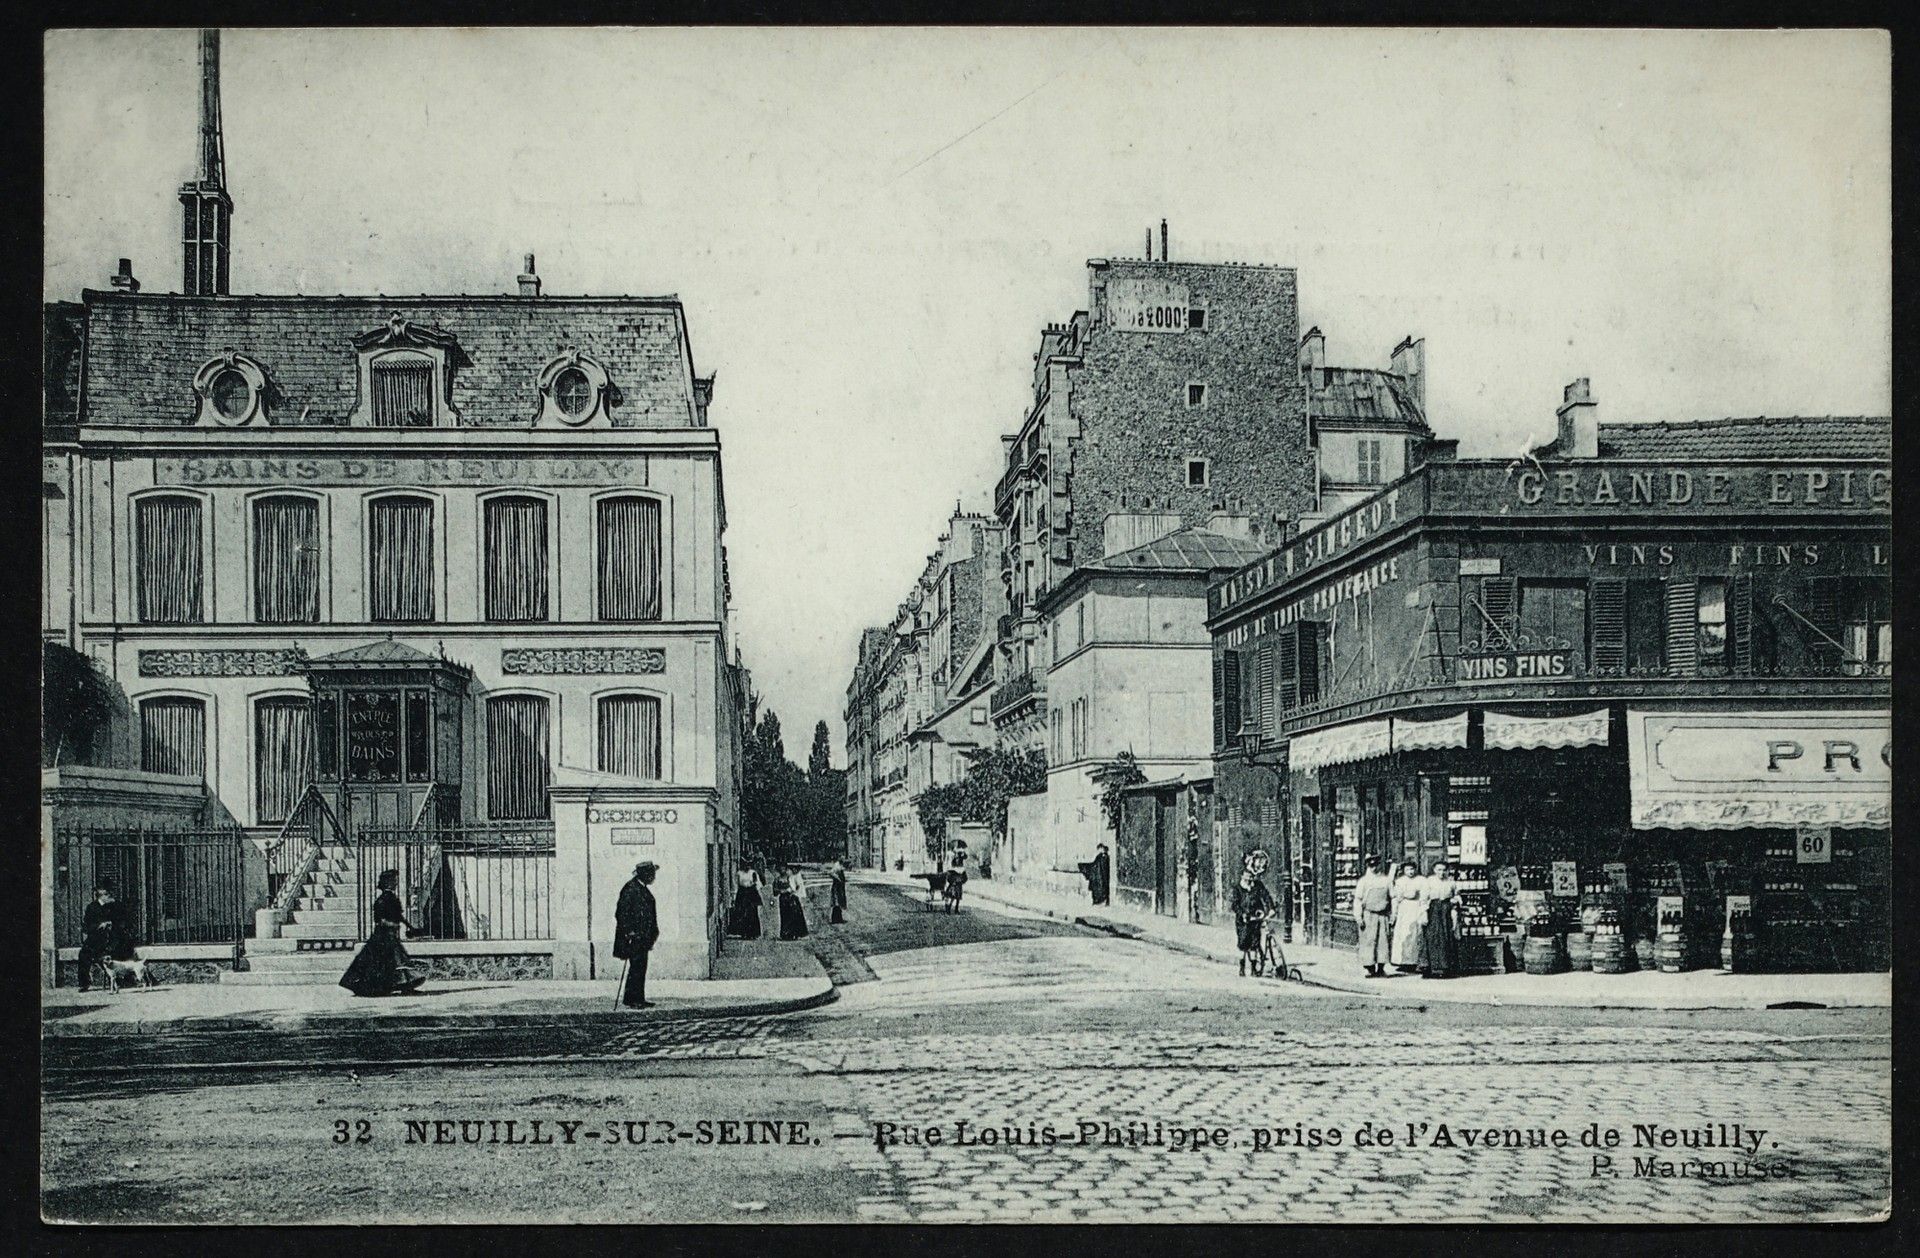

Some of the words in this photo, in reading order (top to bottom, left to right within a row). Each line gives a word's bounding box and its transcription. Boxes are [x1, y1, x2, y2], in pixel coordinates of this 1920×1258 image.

[181, 459, 321, 482] BAINS
[341, 459, 397, 480] DE
[1517, 469, 1731, 505] GRANDE
[1582, 544, 1674, 566] VINS
[1730, 544, 1820, 566] FINS
[1220, 557, 1275, 609] MAISON
[1462, 656, 1509, 680] VINS
[1515, 654, 1566, 677] FINS
[351, 744, 396, 761] BAINS
[1802, 836, 1824, 854] 60
